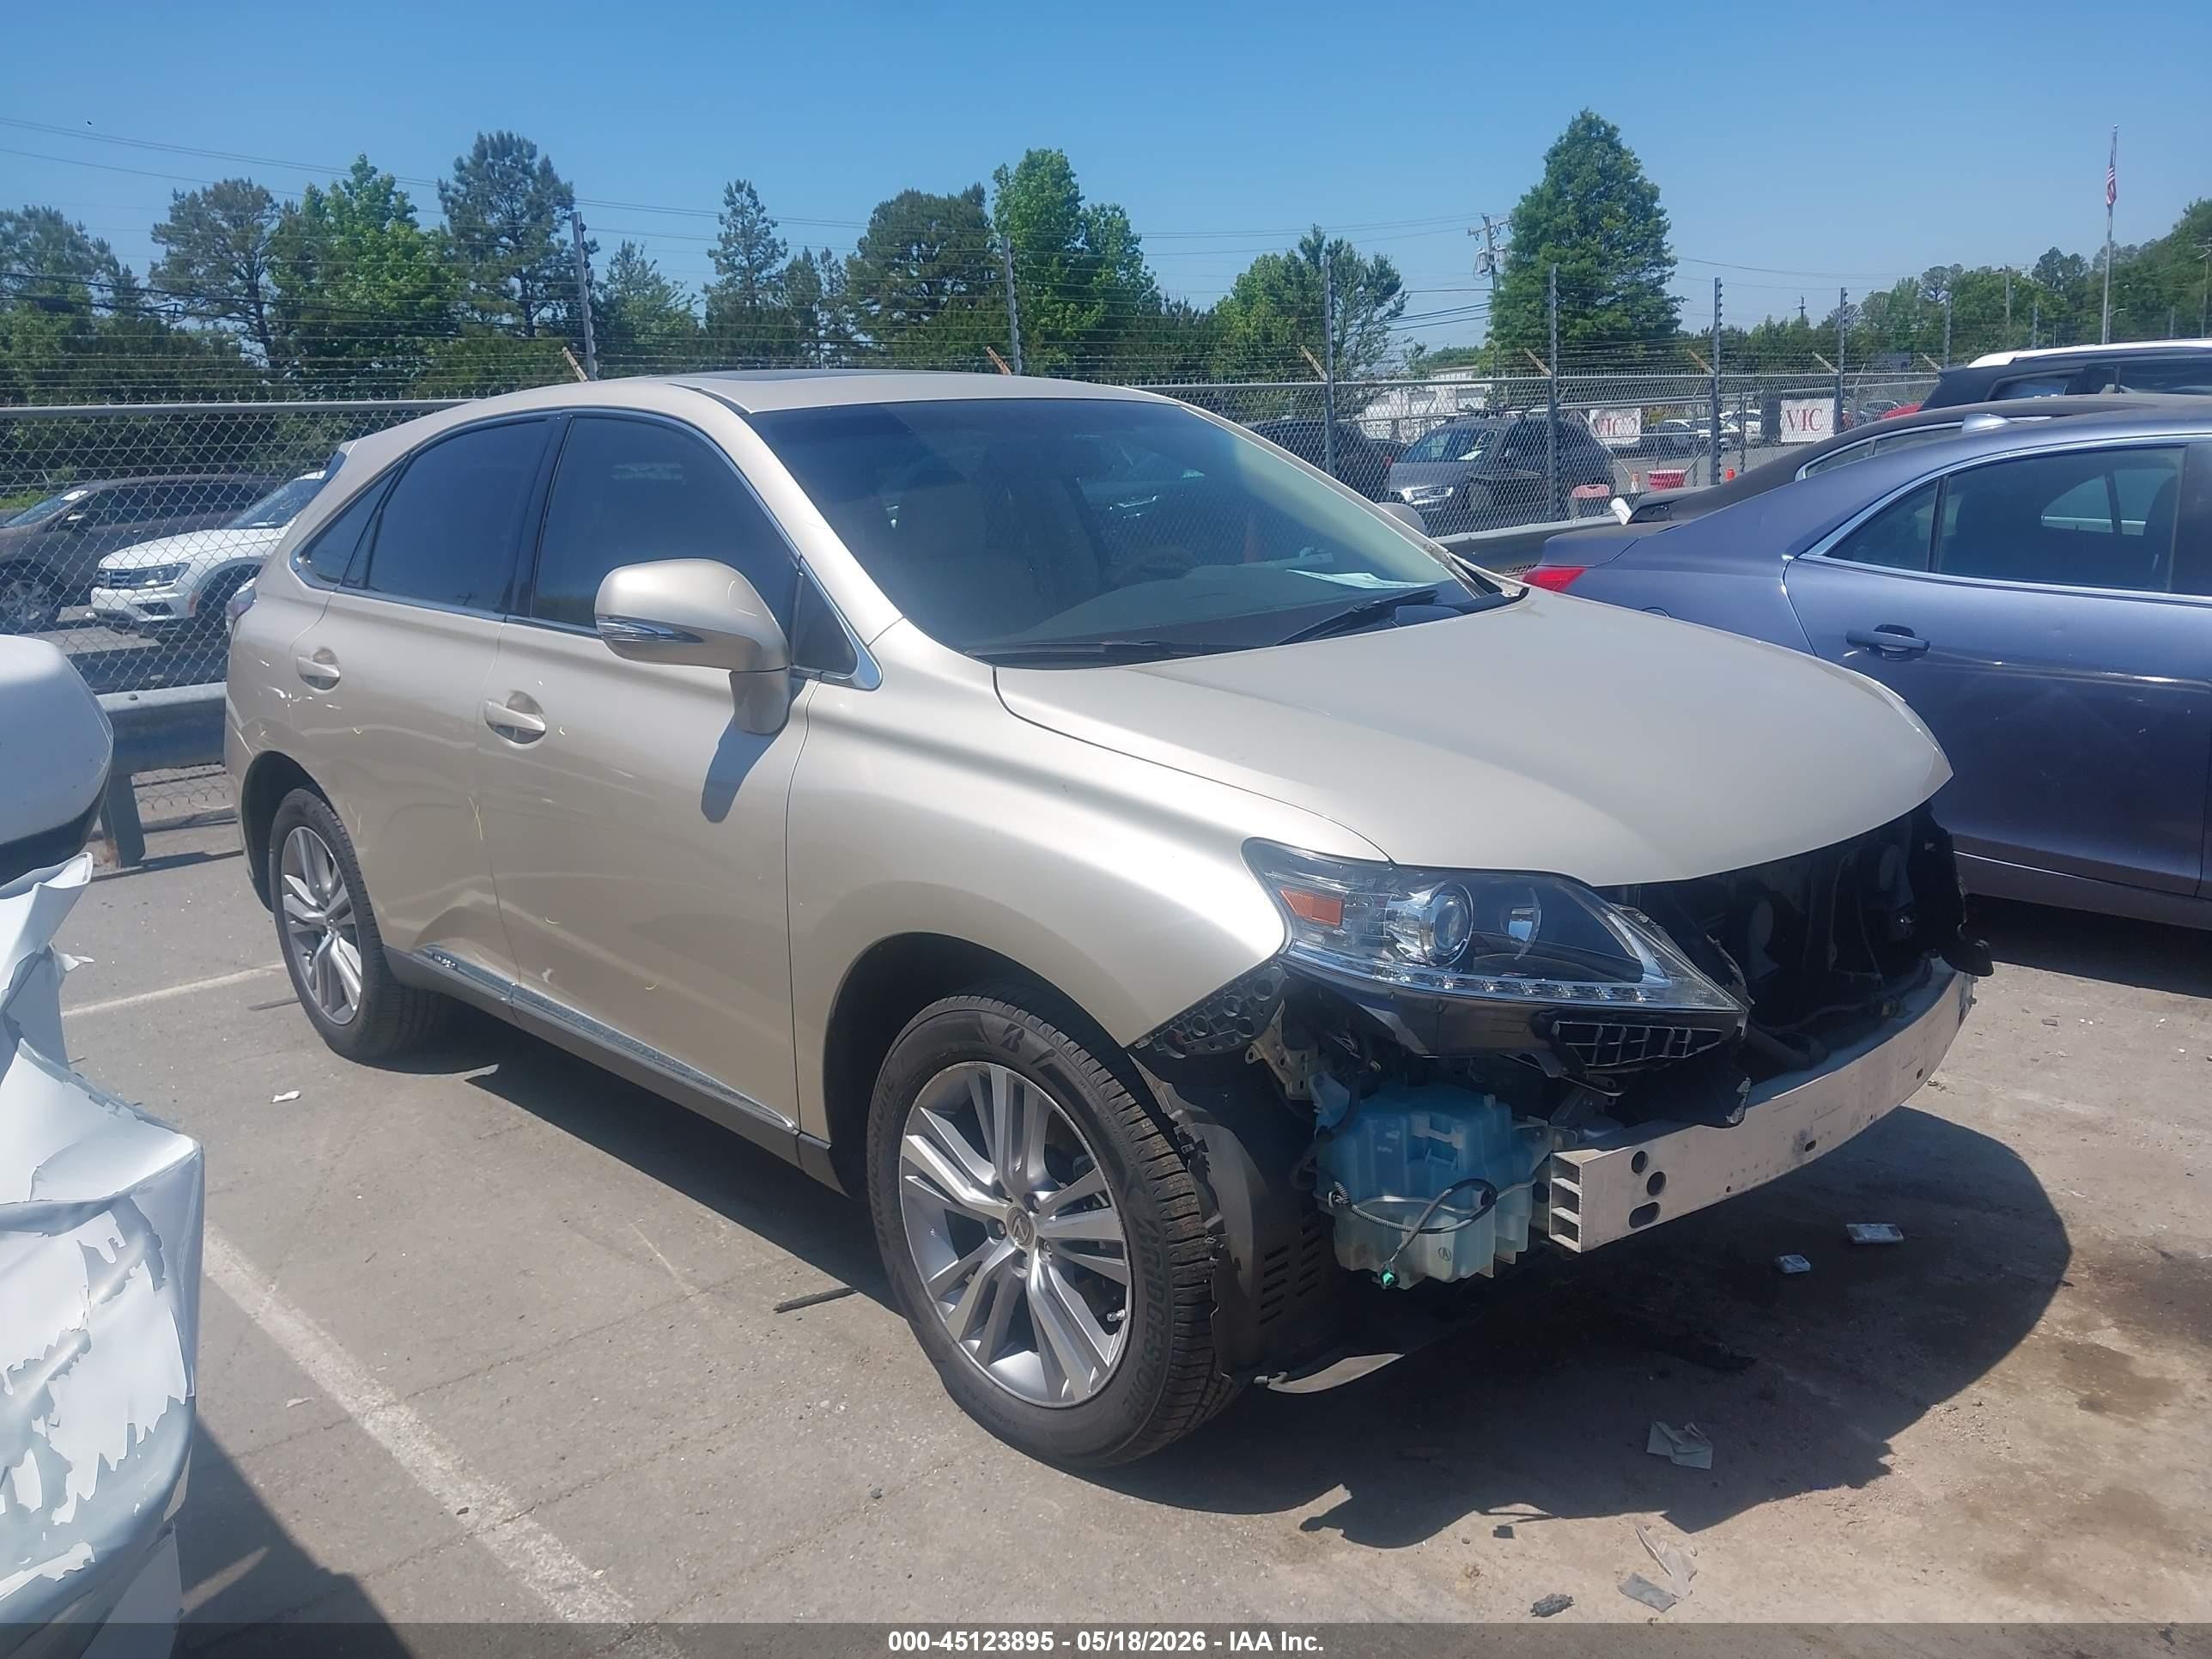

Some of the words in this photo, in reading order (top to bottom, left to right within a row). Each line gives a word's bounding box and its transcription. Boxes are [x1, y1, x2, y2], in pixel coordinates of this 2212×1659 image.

[1593, 417, 1624, 435] VIC
[1786, 408, 1823, 431] VIC
[1121, 1213, 1164, 1420] BRIDGESTONE
